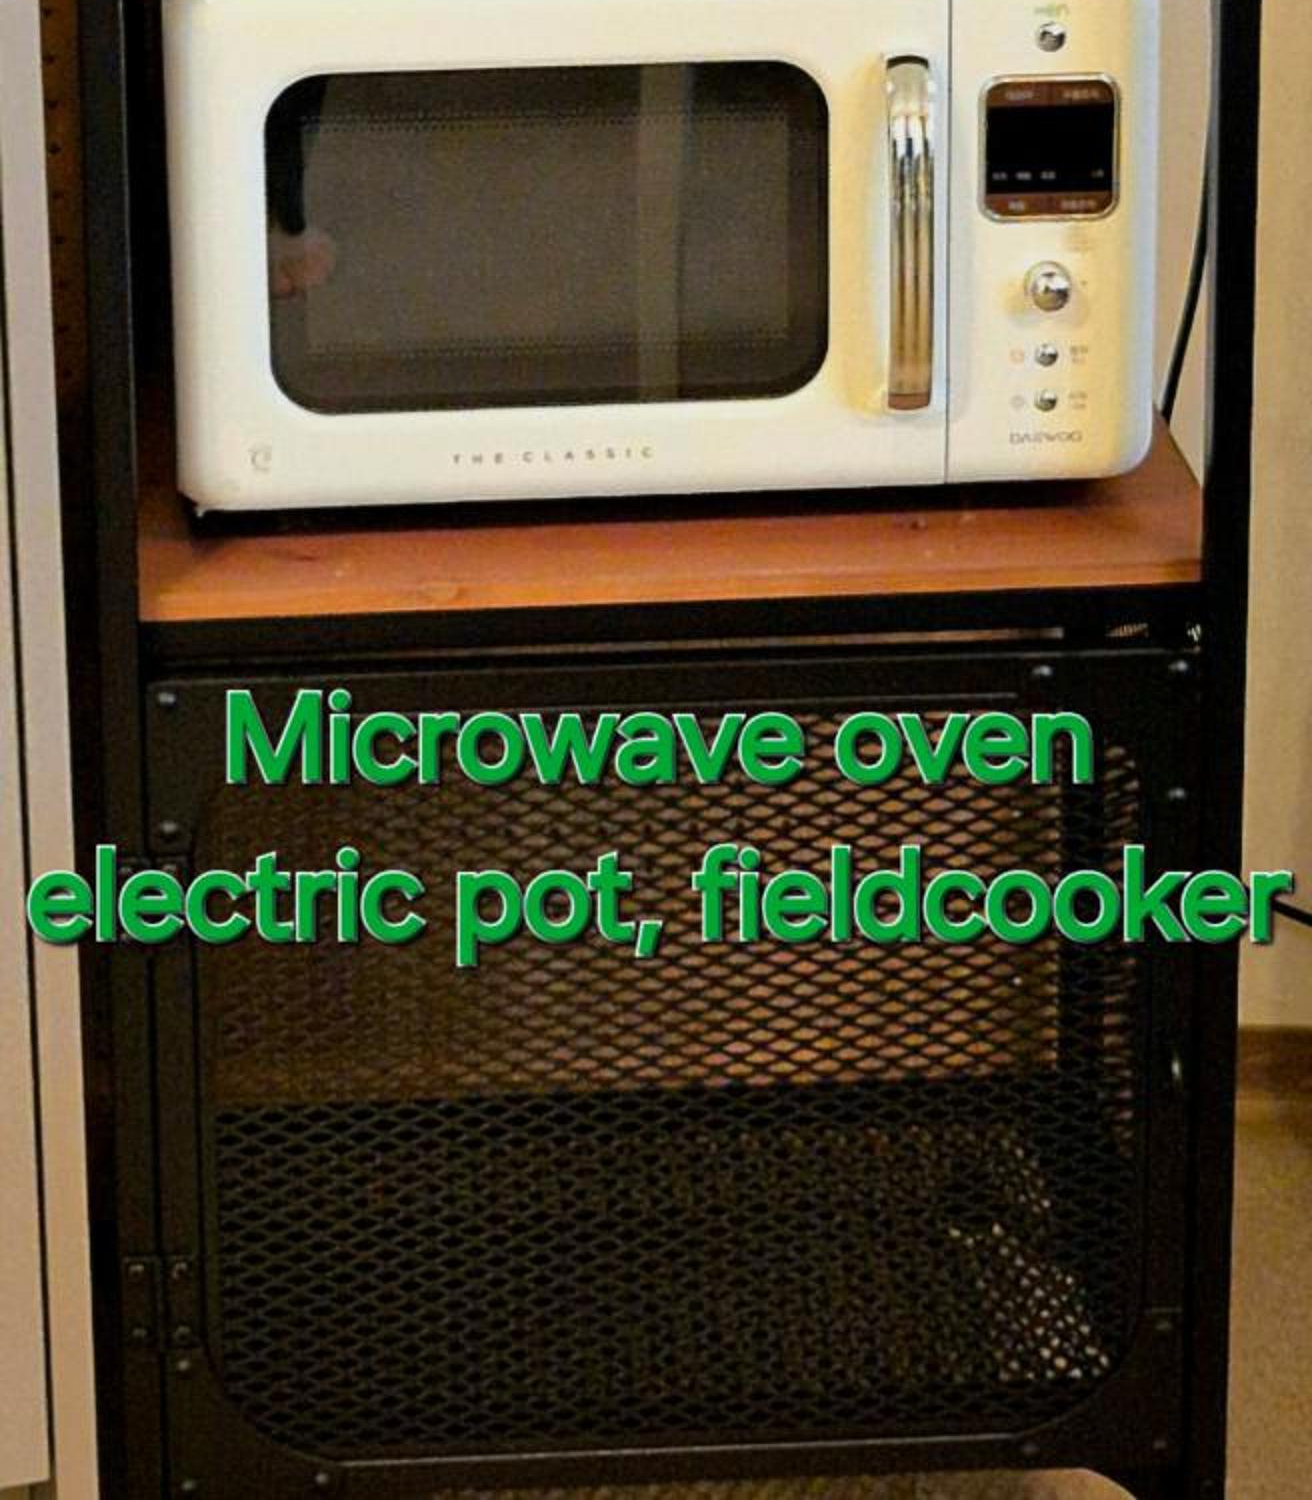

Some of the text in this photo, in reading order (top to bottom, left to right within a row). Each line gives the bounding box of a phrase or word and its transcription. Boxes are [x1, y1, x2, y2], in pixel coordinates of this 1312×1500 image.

[1008, 430, 1083, 446] DAEWOO
[453, 447, 654, 464] THE CLASSIC
